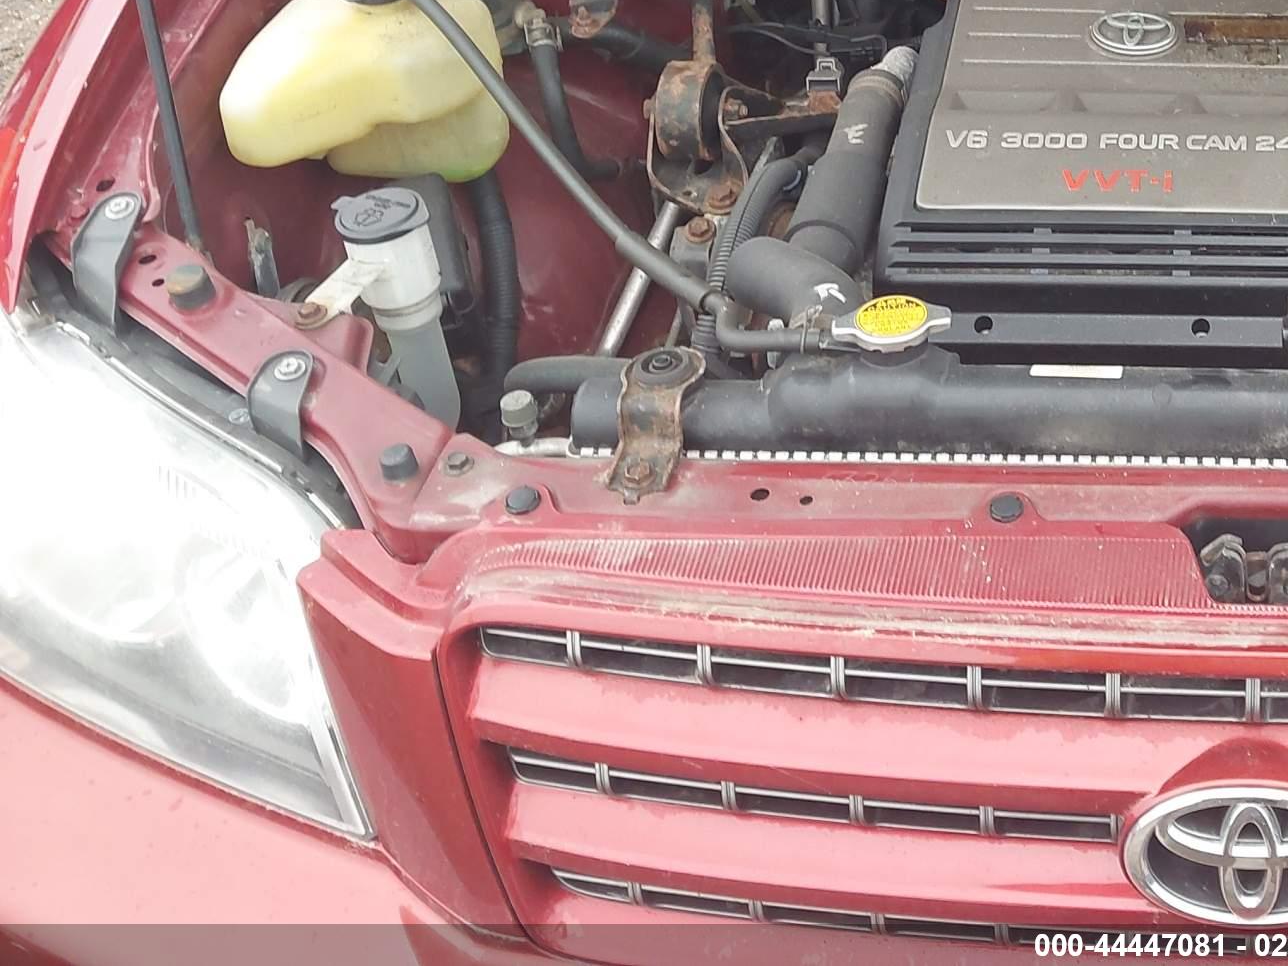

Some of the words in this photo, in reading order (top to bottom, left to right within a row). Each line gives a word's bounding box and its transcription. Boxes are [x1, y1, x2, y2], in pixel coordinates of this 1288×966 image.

[945, 129, 988, 149] V6
[1000, 131, 1088, 150] 3000
[1100, 132, 1180, 151] FOUR
[1185, 134, 1248, 152] CAM
